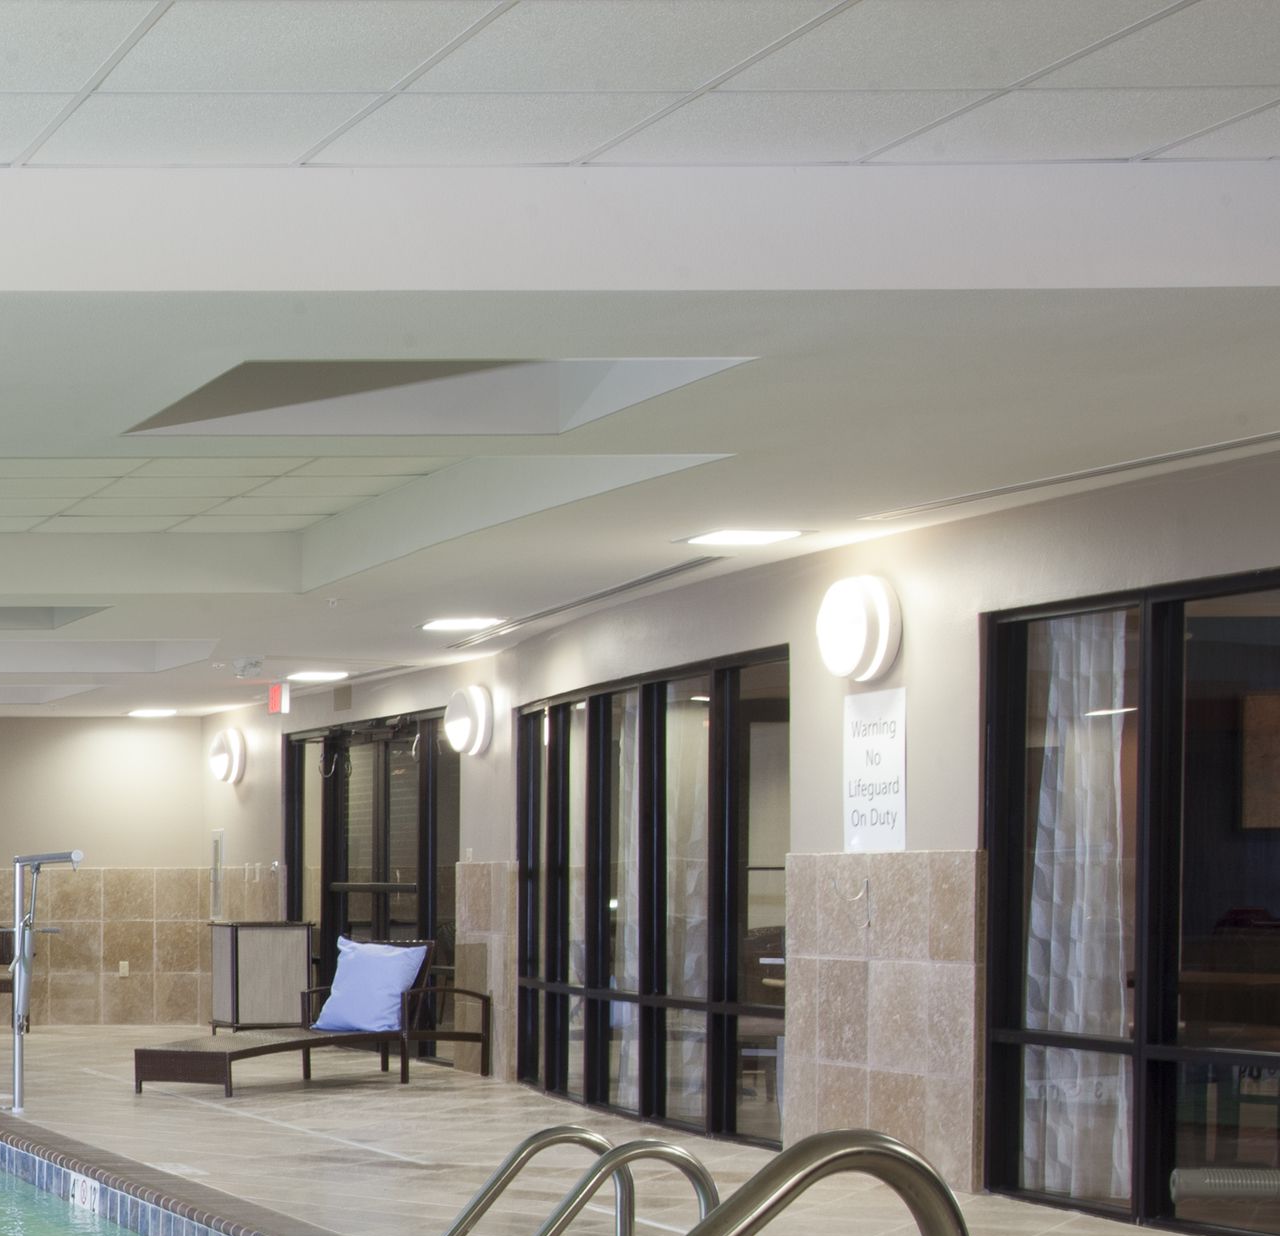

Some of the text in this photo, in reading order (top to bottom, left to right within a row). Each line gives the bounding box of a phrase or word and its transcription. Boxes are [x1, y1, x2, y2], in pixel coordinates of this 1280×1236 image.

[851, 718, 897, 739] Warning
[865, 749, 882, 767] No
[848, 776, 900, 801] Lifeguard
[851, 807, 898, 830] On Duty
